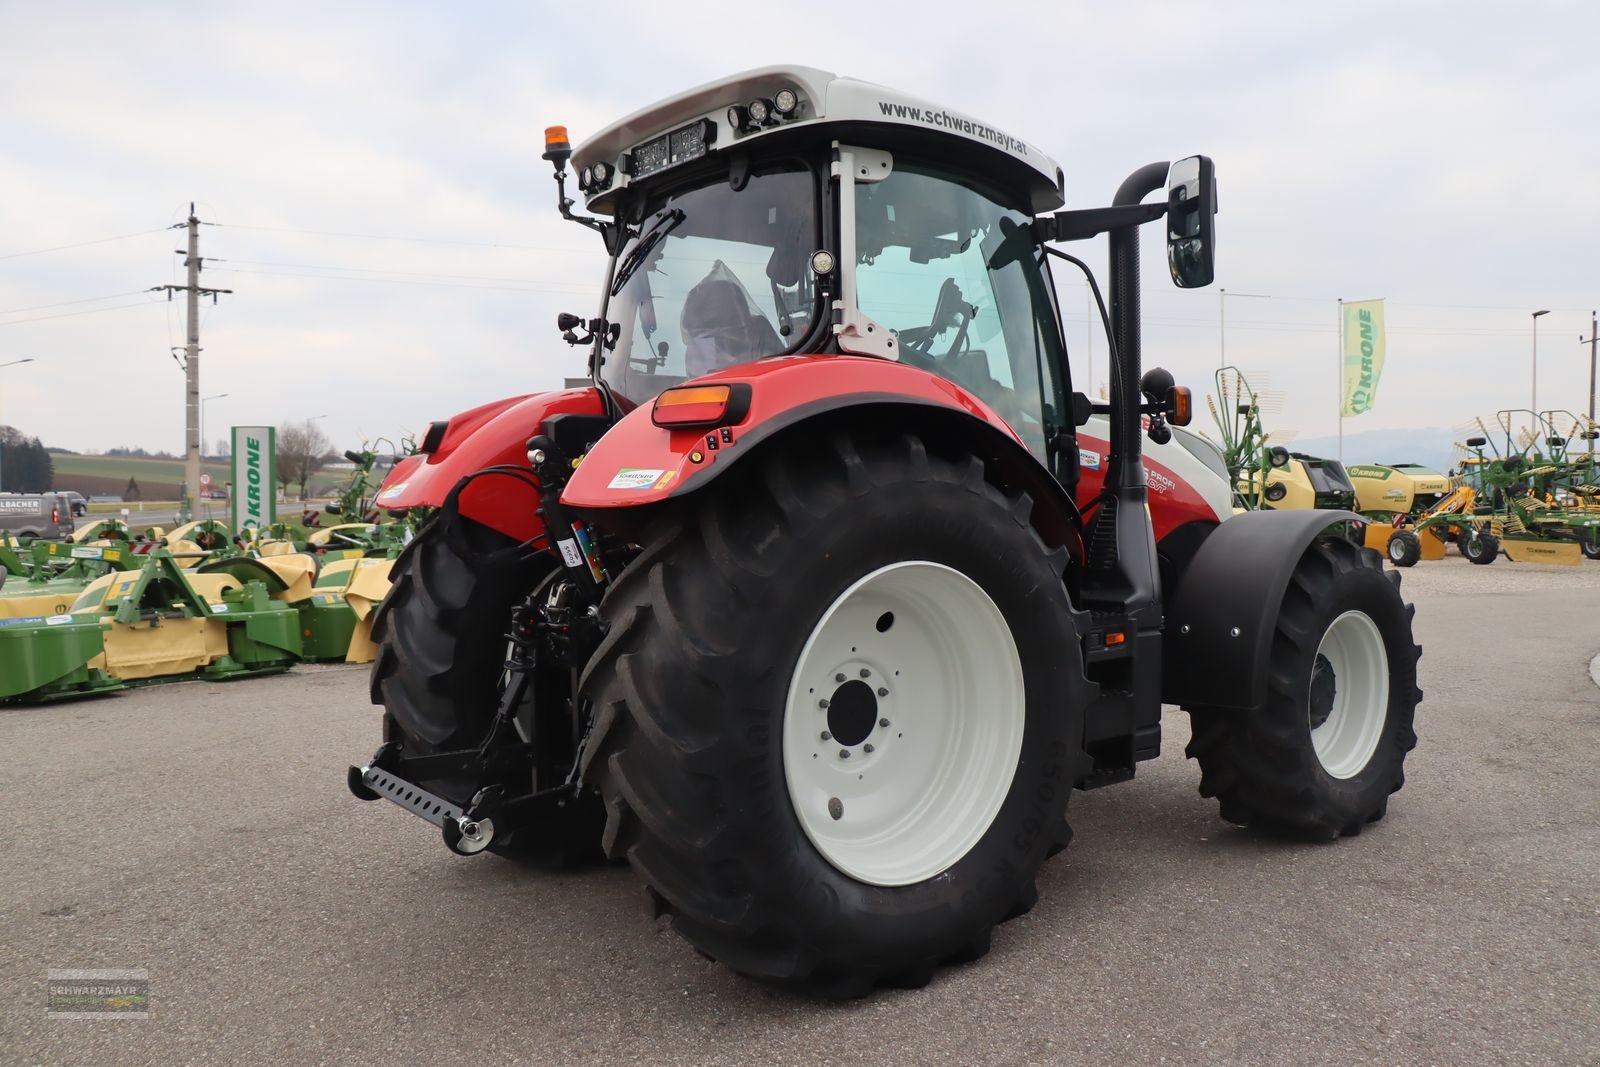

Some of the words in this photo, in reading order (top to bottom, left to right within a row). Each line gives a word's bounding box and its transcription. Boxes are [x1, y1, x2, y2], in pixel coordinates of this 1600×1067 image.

[878, 101, 1028, 156] www.schwarzmayr.at
[1359, 308, 1373, 388] KRONE
[246, 436, 260, 518] KRONE
[1147, 479, 1167, 495] CVT
[1150, 470, 1176, 490] PROFI
[1357, 469, 1386, 479] KRONE
